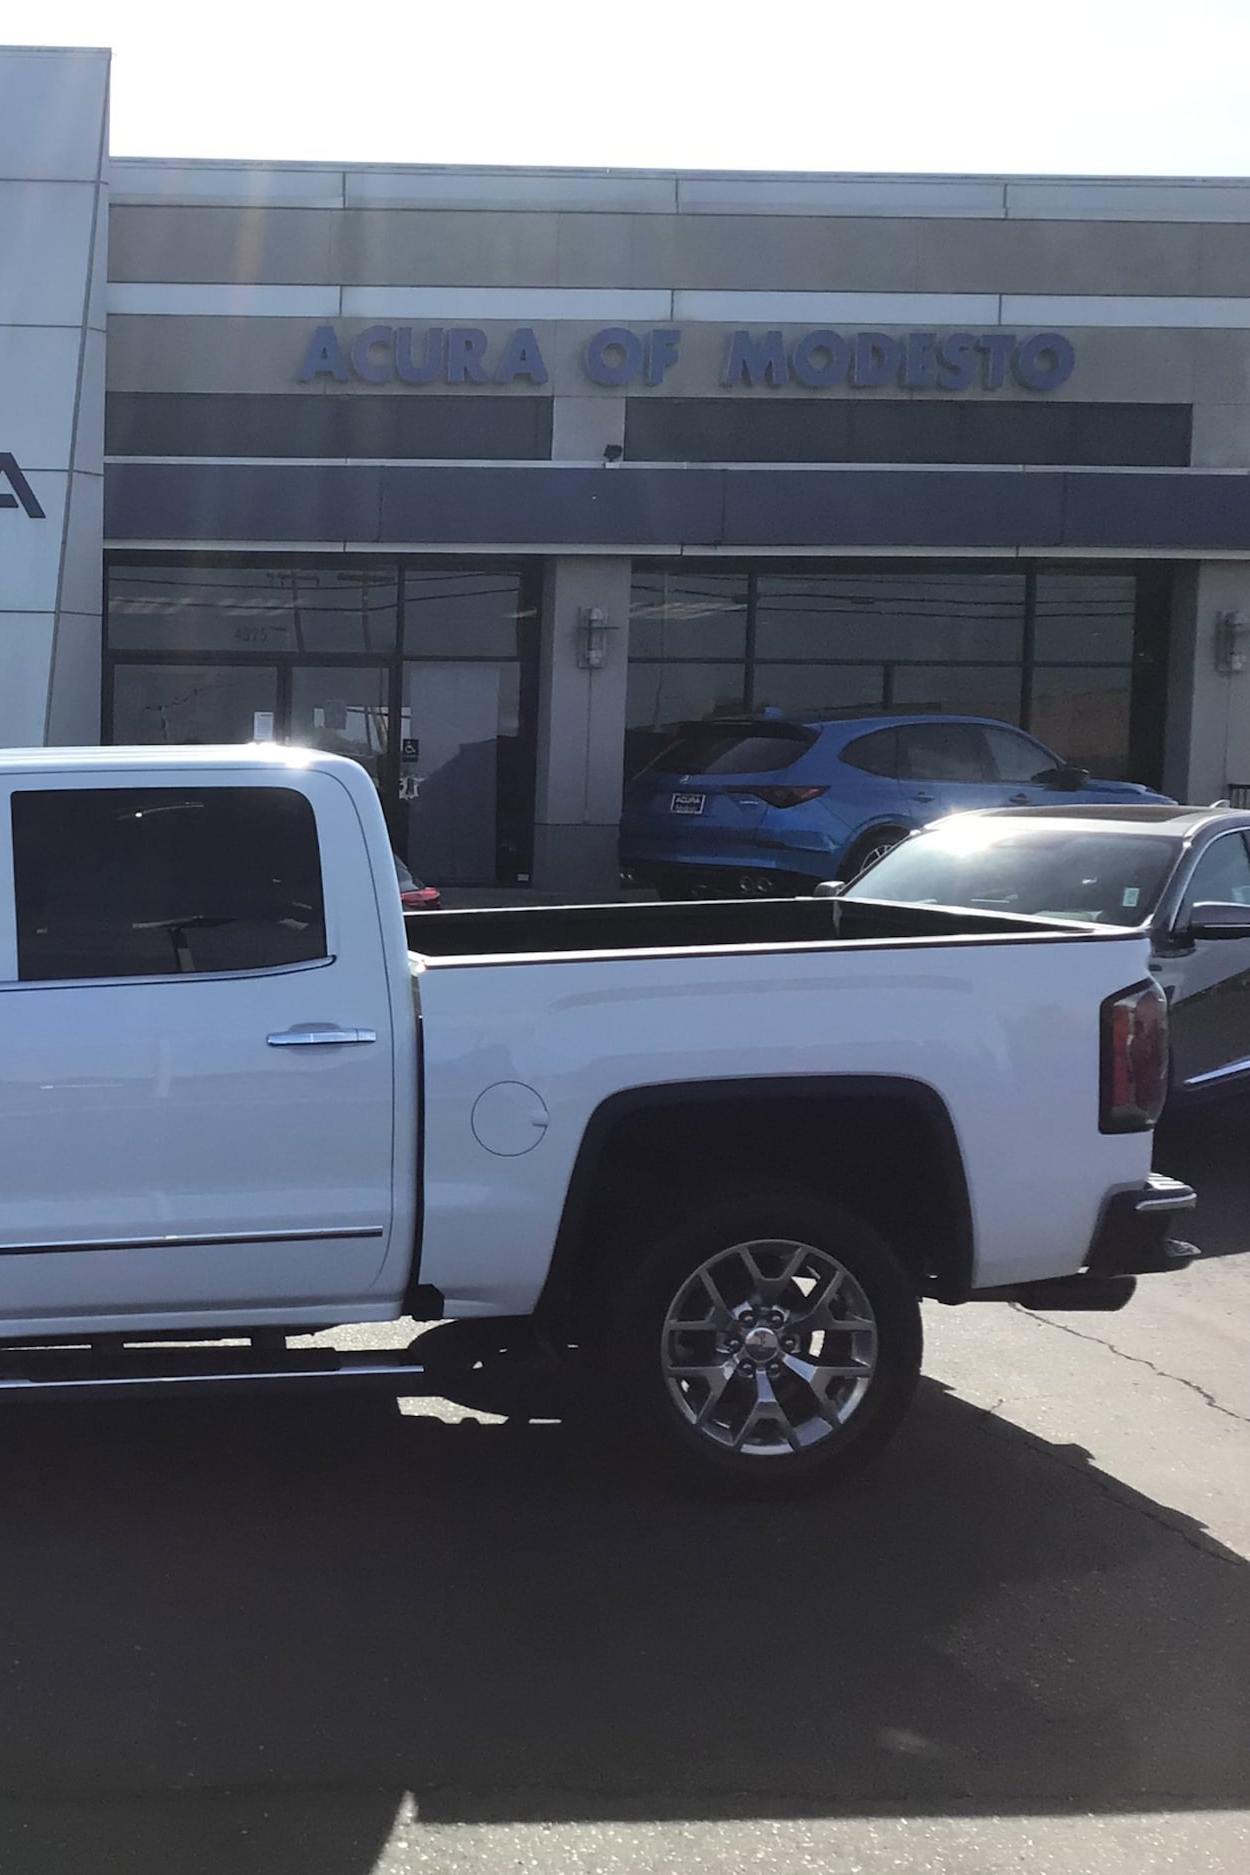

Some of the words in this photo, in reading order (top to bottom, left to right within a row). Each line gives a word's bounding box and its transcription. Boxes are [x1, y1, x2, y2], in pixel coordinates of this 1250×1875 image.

[298, 325, 548, 386] ACURA
[586, 327, 681, 387] OF
[720, 329, 1076, 392] MODESTO
